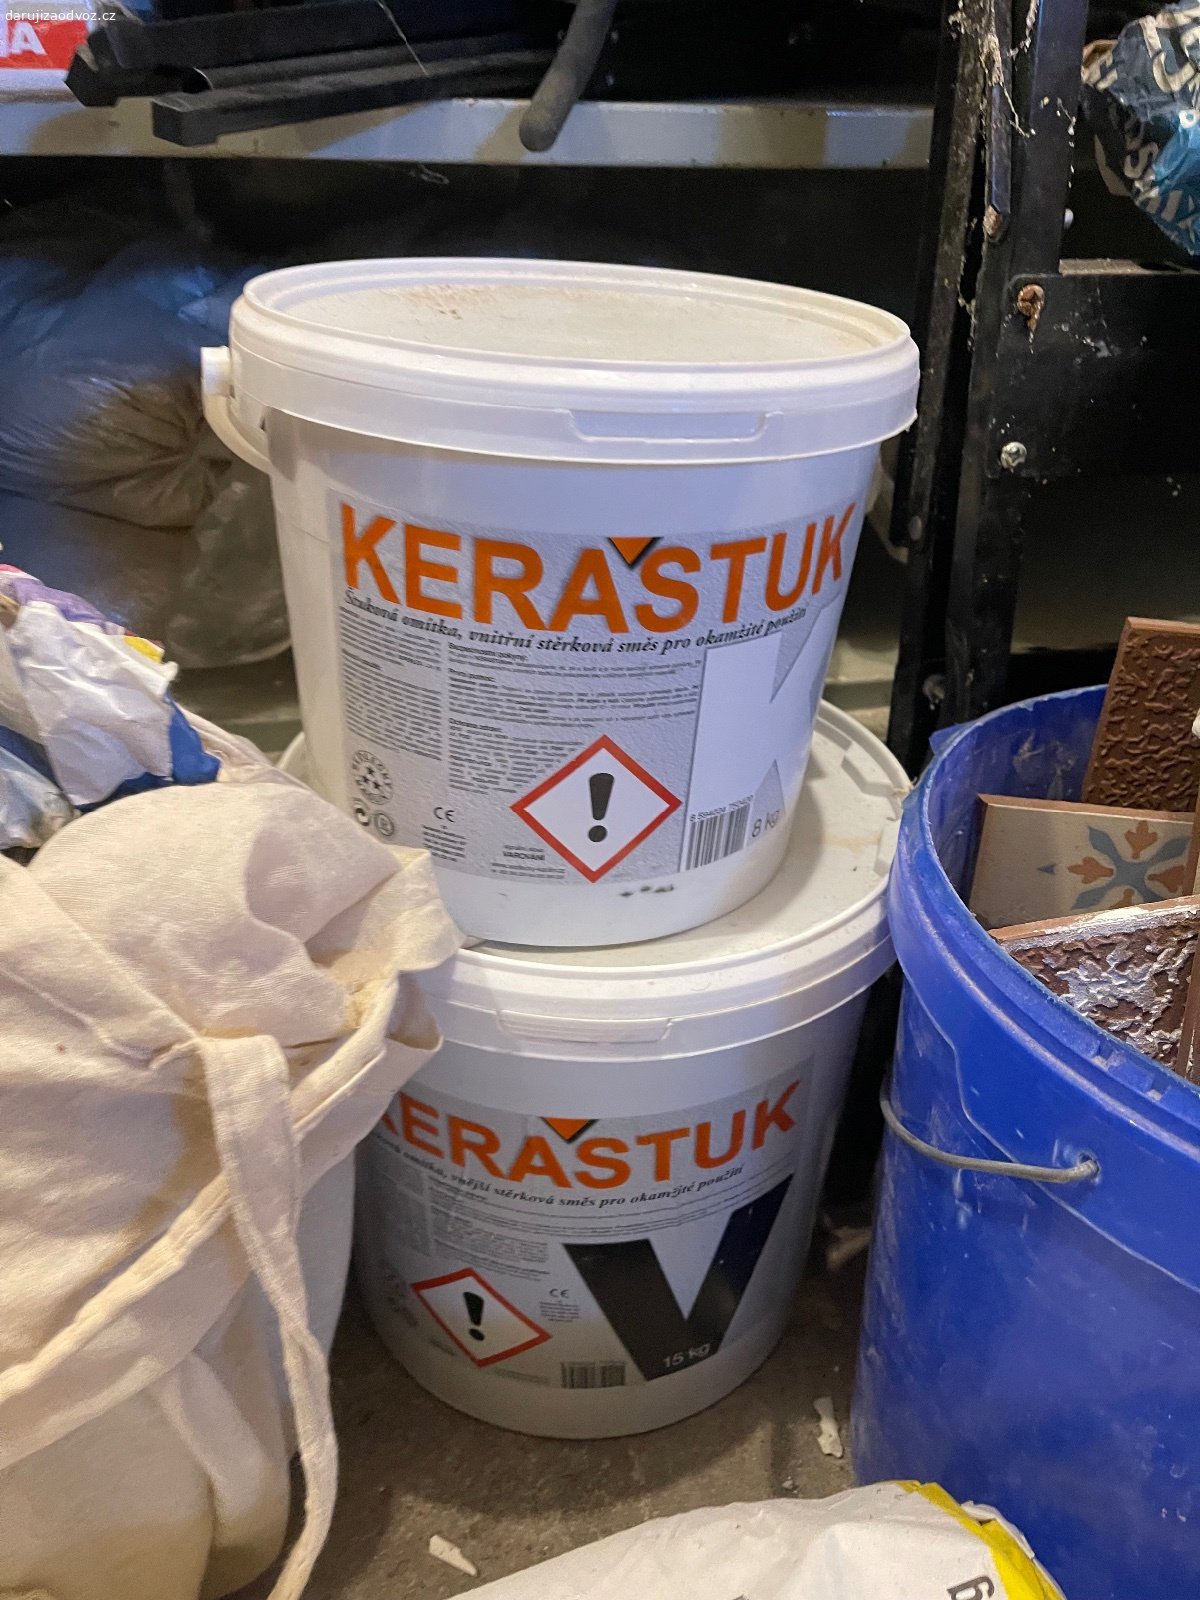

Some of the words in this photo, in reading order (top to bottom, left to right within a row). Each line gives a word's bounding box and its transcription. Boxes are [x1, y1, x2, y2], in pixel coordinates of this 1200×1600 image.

[537, 635, 615, 653] stěrková
[617, 636, 659, 652] směs
[660, 639, 691, 656] pro
[696, 618, 767, 646] okamžité
[751, 817, 763, 838] 8
[764, 808, 781, 831] kg
[381, 1079, 801, 1190] ERASTUK
[494, 1184, 554, 1205] stěrková
[558, 1195, 596, 1207] směs
[598, 1196, 626, 1208] pro
[663, 1352, 685, 1368] 15
[688, 1343, 711, 1359] kg
